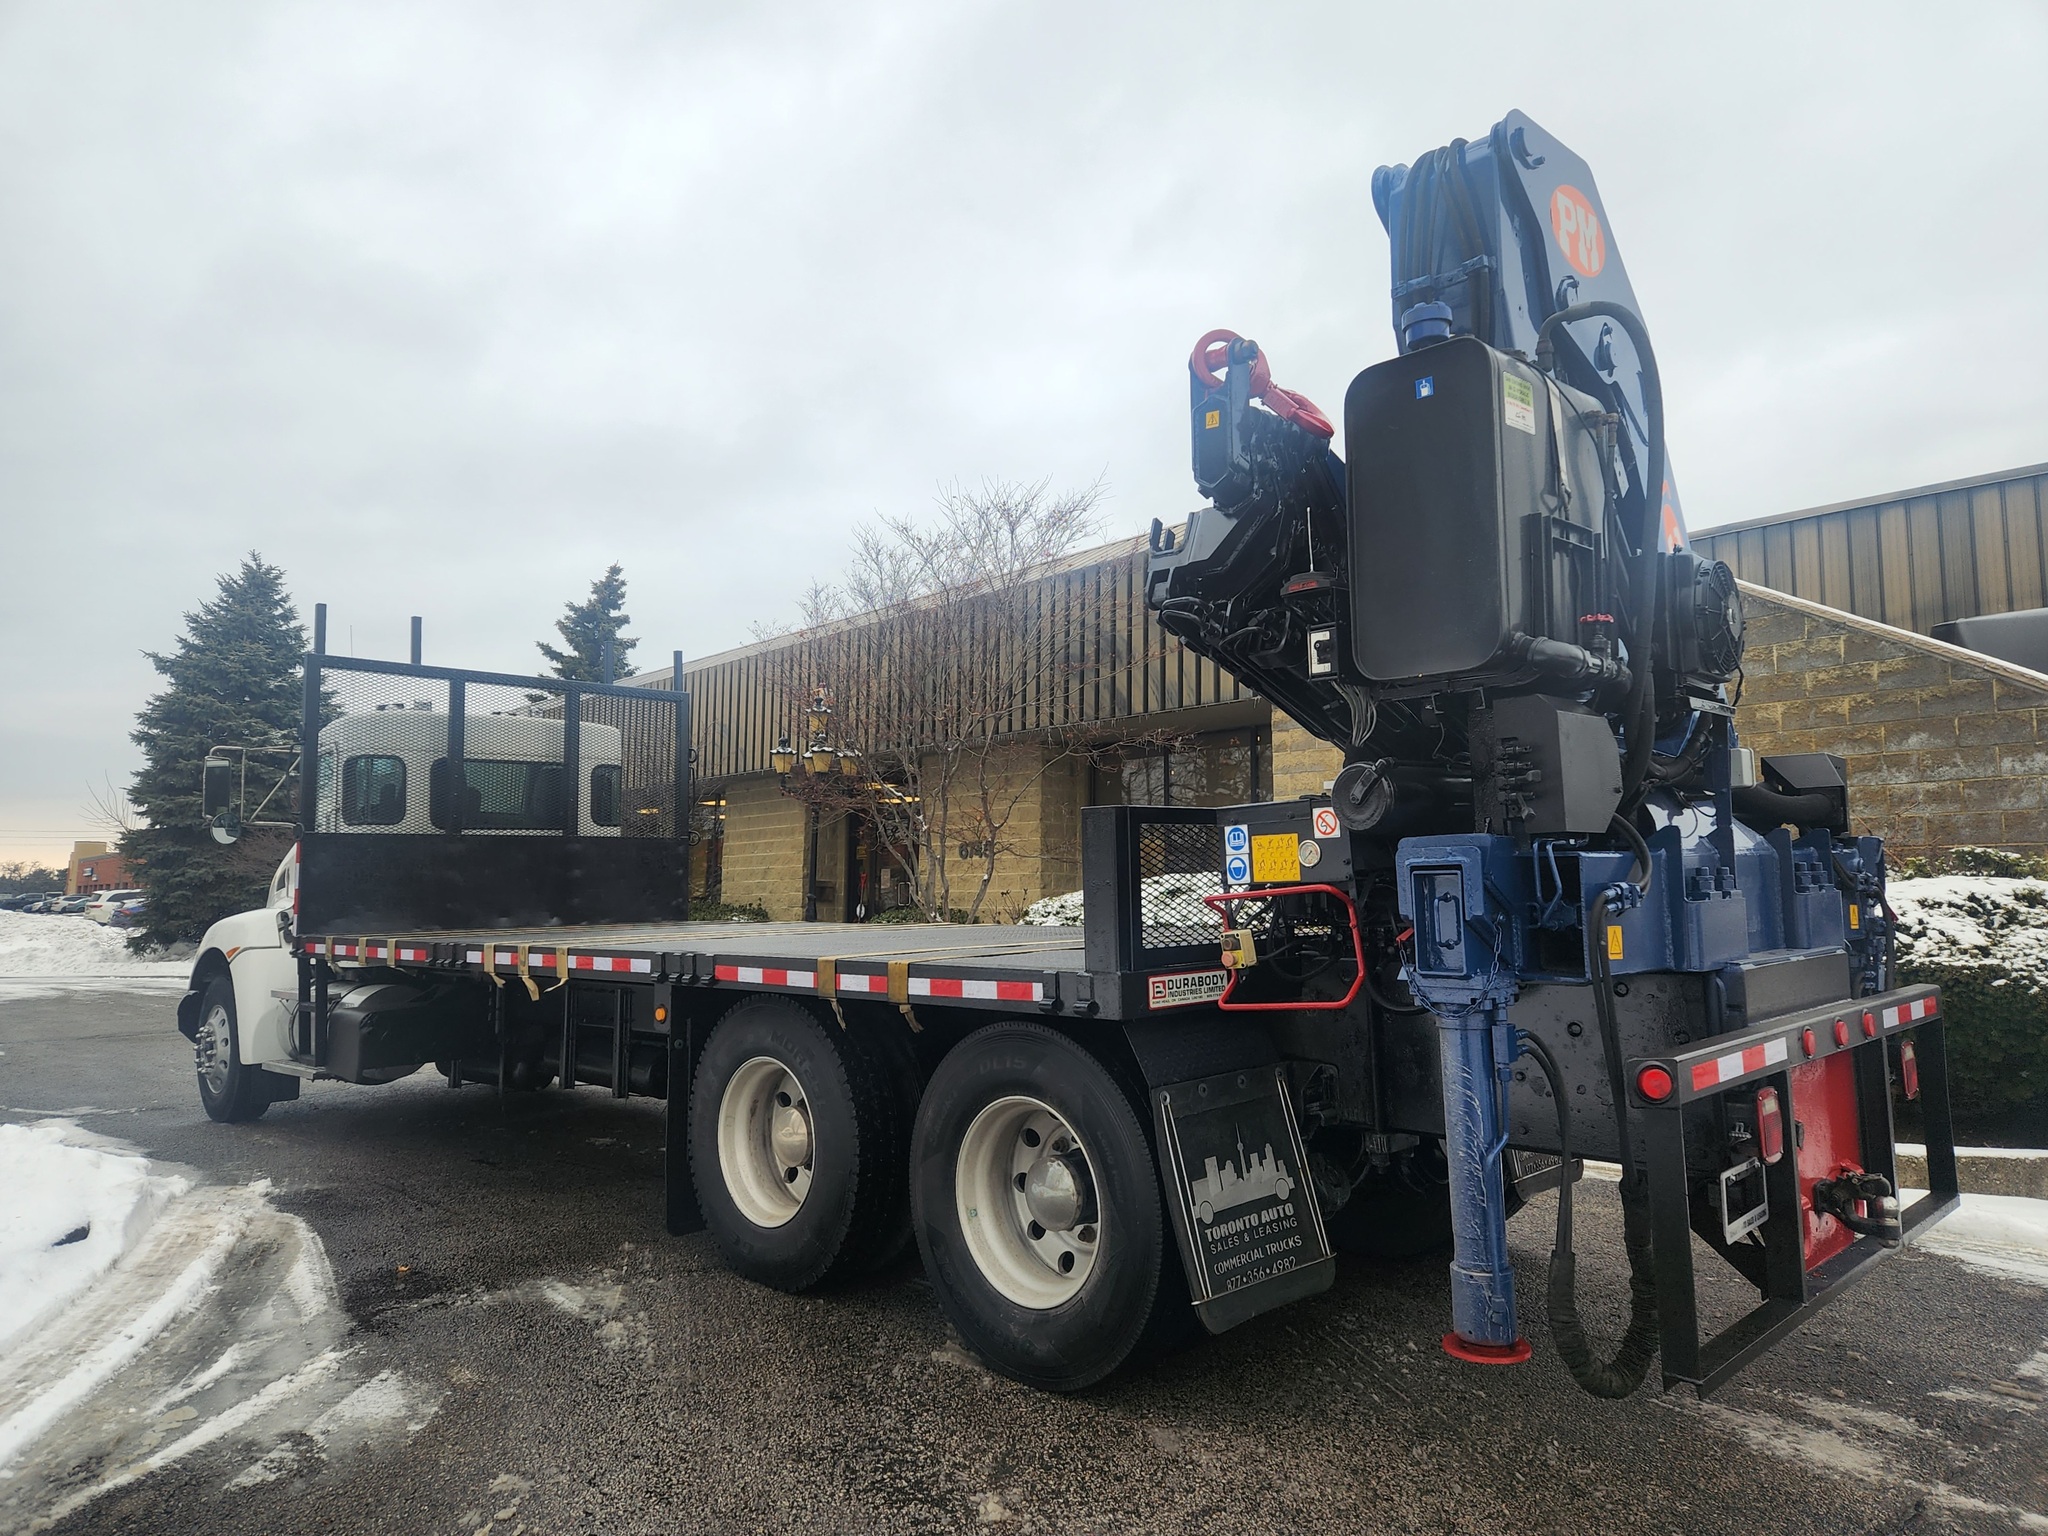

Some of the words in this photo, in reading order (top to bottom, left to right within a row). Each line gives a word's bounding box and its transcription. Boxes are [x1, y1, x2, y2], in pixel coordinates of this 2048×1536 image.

[1556, 191, 1599, 273] PM
[1167, 974, 1225, 990] DURABODY
[1167, 987, 1203, 999] INDUSTRIES
[1203, 985, 1226, 994] LIMITED
[1205, 1213, 1260, 1242] TORONTO
[1261, 1202, 1294, 1224] AUTO
[1210, 1235, 1240, 1255] SALES
[1243, 1232, 1250, 1242] &
[1253, 1217, 1298, 1239] LEASING
[1214, 1247, 1265, 1275] COMMERCIAL
[1265, 1235, 1302, 1256] TRUCKS
